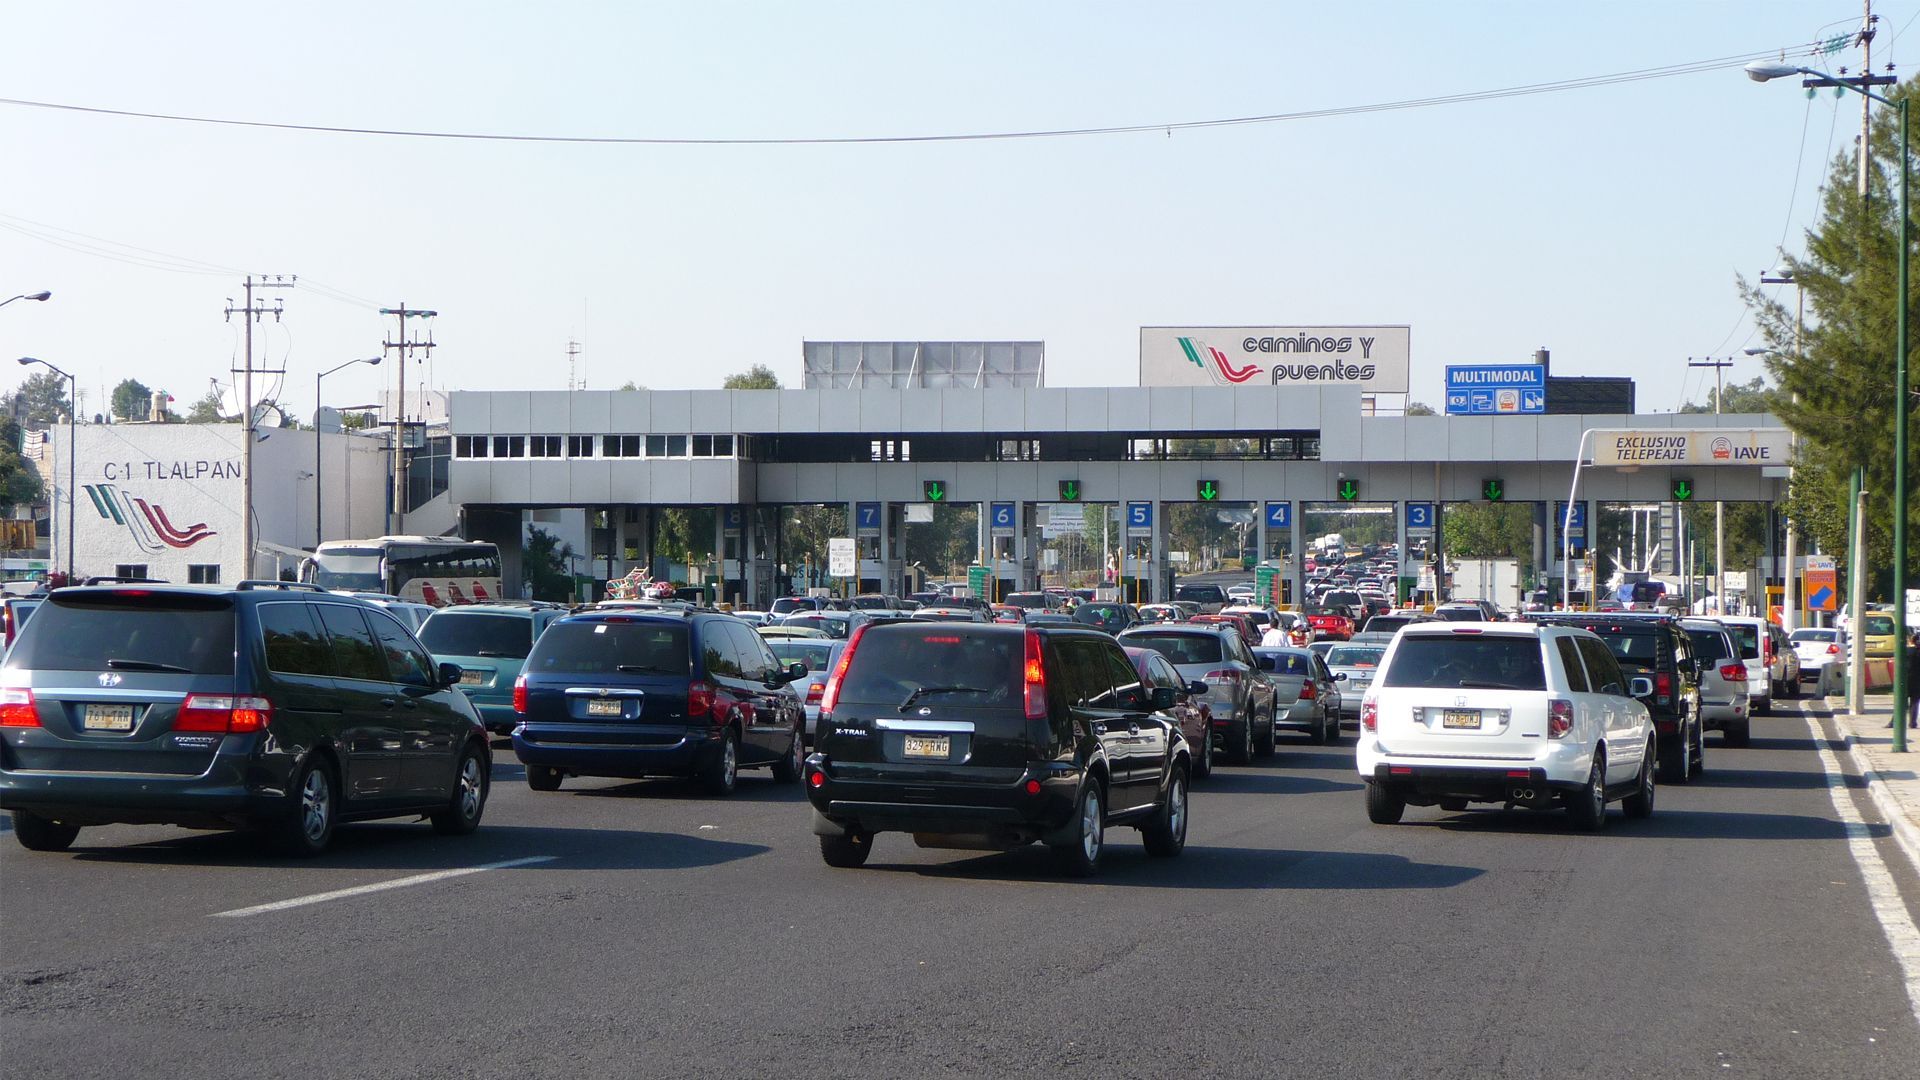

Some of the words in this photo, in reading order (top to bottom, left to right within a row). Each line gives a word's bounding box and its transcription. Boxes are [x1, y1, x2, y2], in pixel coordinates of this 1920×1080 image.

[1243, 332, 1352, 353] caminos
[1271, 359, 1375, 385] puentes
[1453, 370, 1537, 383] MULTIMODAL
[1616, 437, 1686, 449] EXCLUSIVO
[1616, 449, 1686, 460] TELEPEAJE
[1734, 446, 1770, 459] IAVE
[143, 461, 241, 479] TLALPAN
[730, 509, 741, 524] 8
[863, 508, 874, 524] 7
[997, 508, 1009, 523] 6
[1134, 507, 1146, 523] 5
[1271, 508, 1285, 523] 4
[1413, 507, 1425, 523] 3
[1566, 508, 1578, 523] 2
[835, 728, 868, 737] X-TRAIL
[906, 739, 948, 753] 329-RWG
